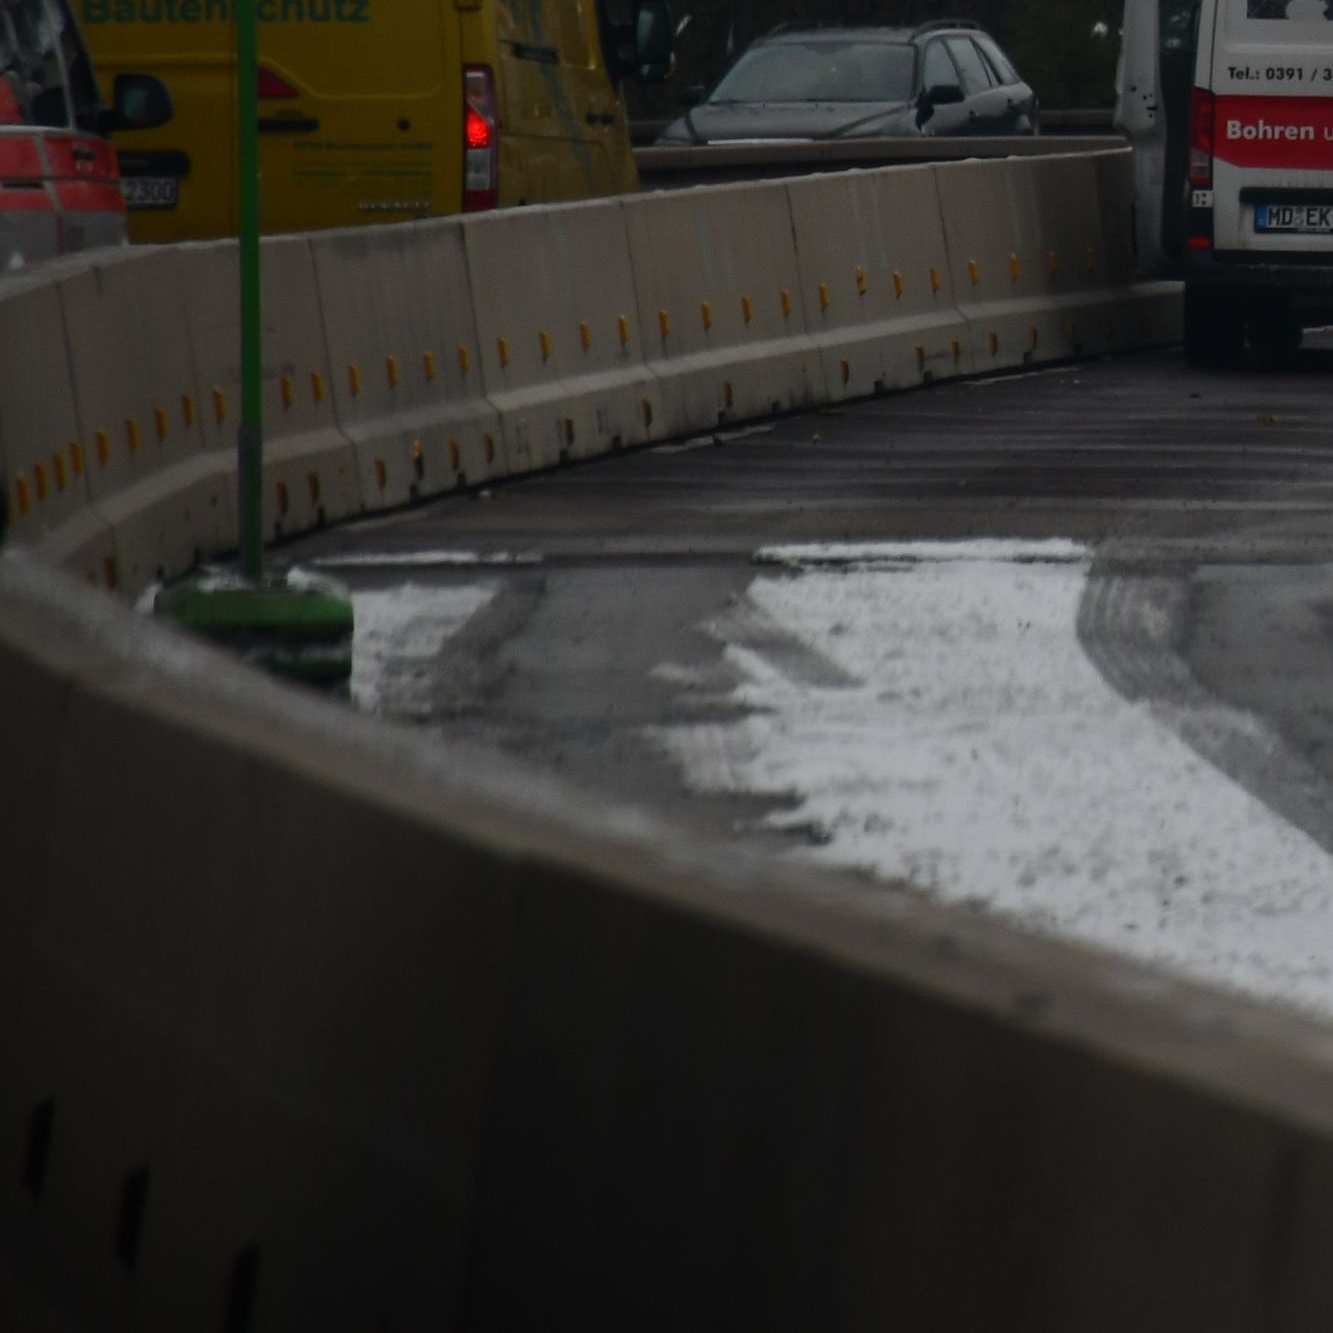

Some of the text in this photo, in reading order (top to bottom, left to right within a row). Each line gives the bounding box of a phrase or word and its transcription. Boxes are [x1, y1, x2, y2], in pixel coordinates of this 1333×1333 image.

[1228, 67, 1260, 80] Tel.:
[1266, 67, 1303, 81] 0391
[1311, 68, 1318, 82] /
[1226, 119, 1315, 141] Bohren
[1268, 207, 1293, 226] MD
[1306, 207, 1331, 226] EK
